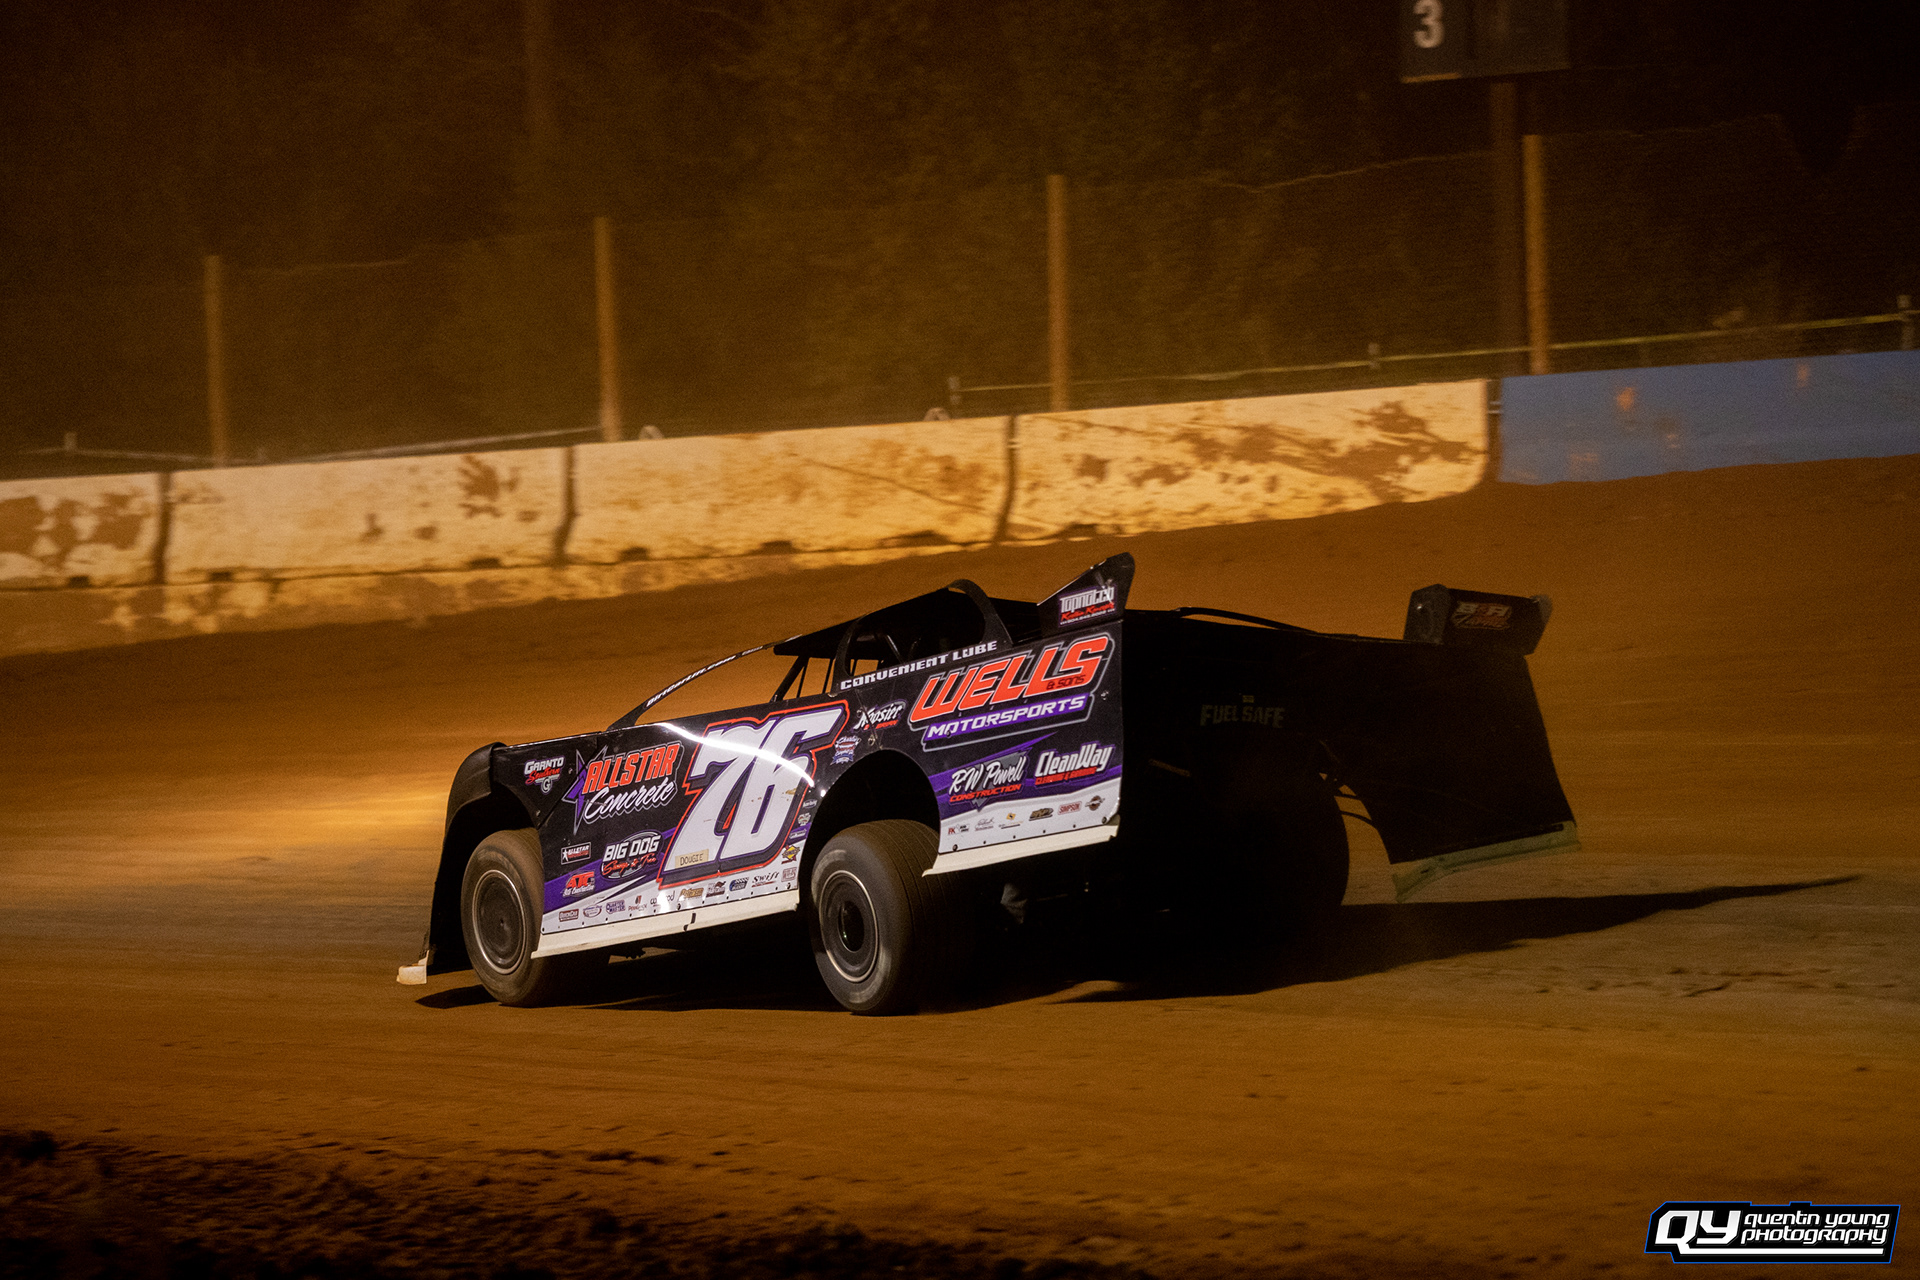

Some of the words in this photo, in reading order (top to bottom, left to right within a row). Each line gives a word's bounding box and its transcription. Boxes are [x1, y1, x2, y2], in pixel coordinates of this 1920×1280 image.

[1413, 0, 1444, 48] 3
[840, 654, 949, 690] CONVENIENT
[952, 641, 998, 661] LUBE
[910, 636, 1109, 722] WELLS
[927, 695, 1087, 741] MOTORSPORTS
[1200, 704, 1241, 727] FUEL
[1241, 704, 1285, 728] SAFE
[582, 743, 680, 794] ALLSTAR
[949, 764, 985, 795] RW
[983, 756, 1027, 788] Powell
[1035, 743, 1114, 778] CleanWay
[584, 776, 676, 820] Concrete
[662, 708, 844, 872] 76
[950, 784, 1023, 803] CONSTRUCTION
[603, 841, 629, 862] BIG
[629, 835, 661, 857] DOG
[680, 852, 704, 866] DOUGIE
[566, 872, 595, 889] ATC
[751, 870, 780, 884] Swift
